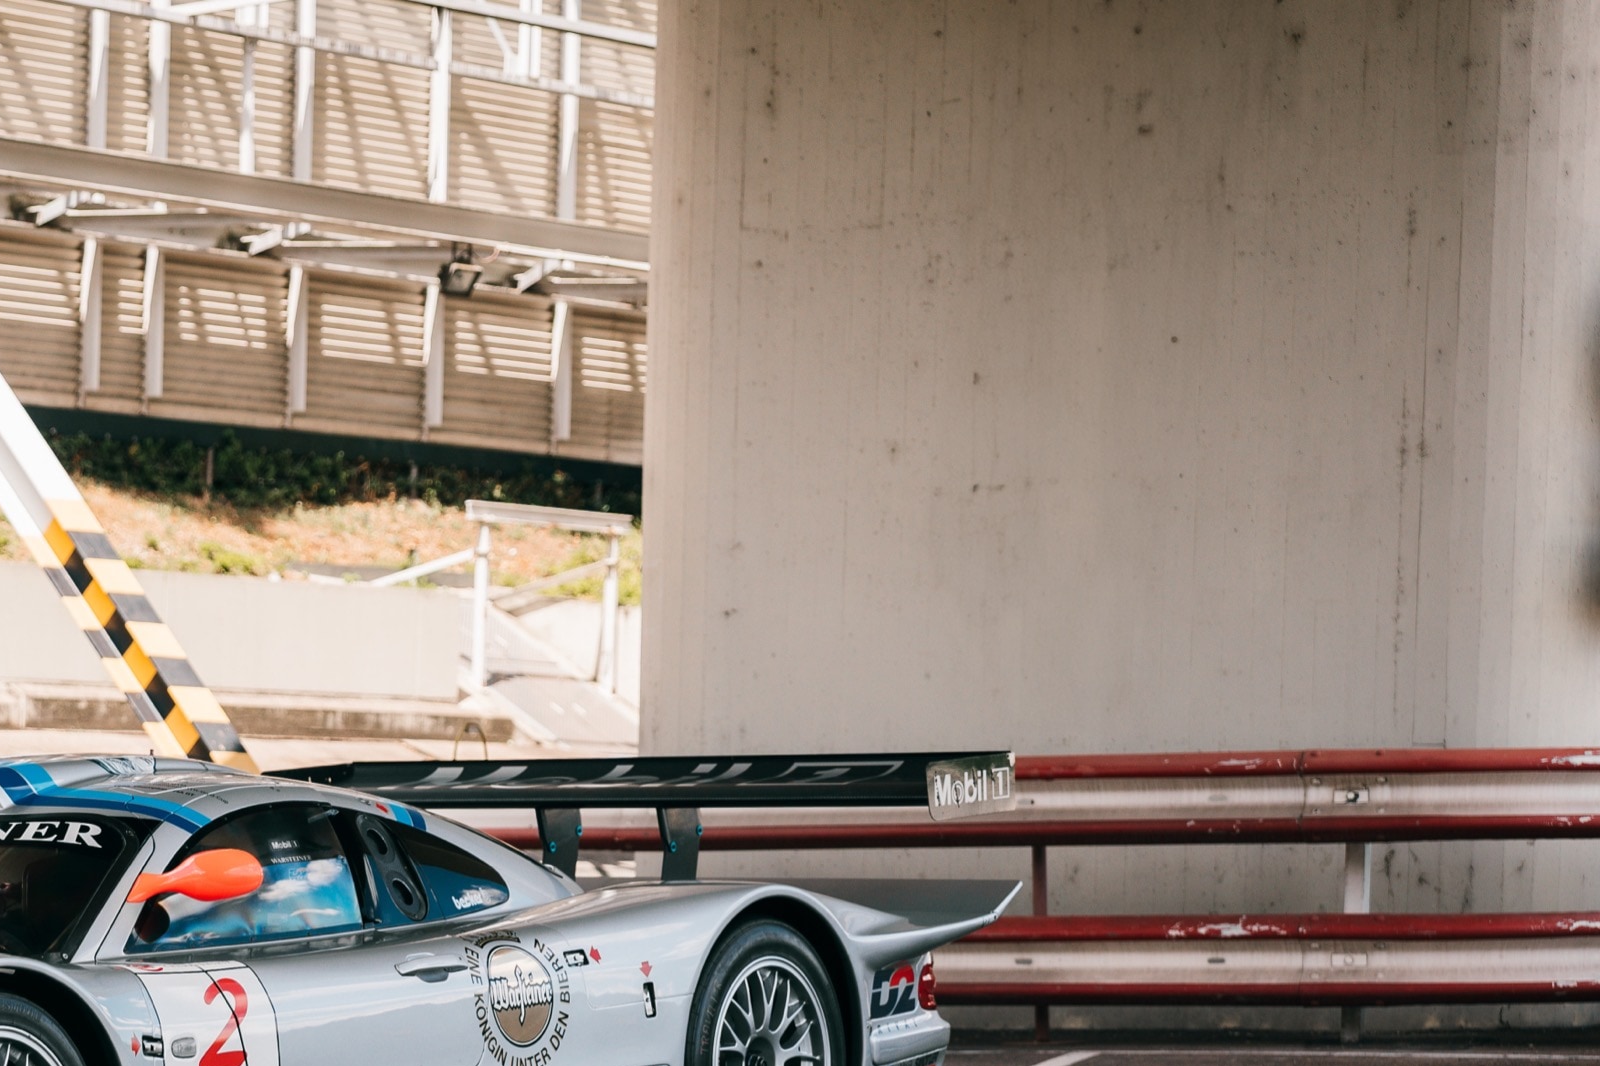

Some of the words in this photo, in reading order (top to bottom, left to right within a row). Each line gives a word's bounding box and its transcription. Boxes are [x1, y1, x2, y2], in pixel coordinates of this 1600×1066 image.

[934, 769, 988, 807] Mobil
[271, 840, 292, 849] Mobil
[465, 946, 483, 985] EINE
[534, 938, 570, 1004] BIEREN
[870, 960, 916, 1019] D2
[474, 993, 507, 1066] KÖNIGIN
[550, 1011, 569, 1051] DEN
